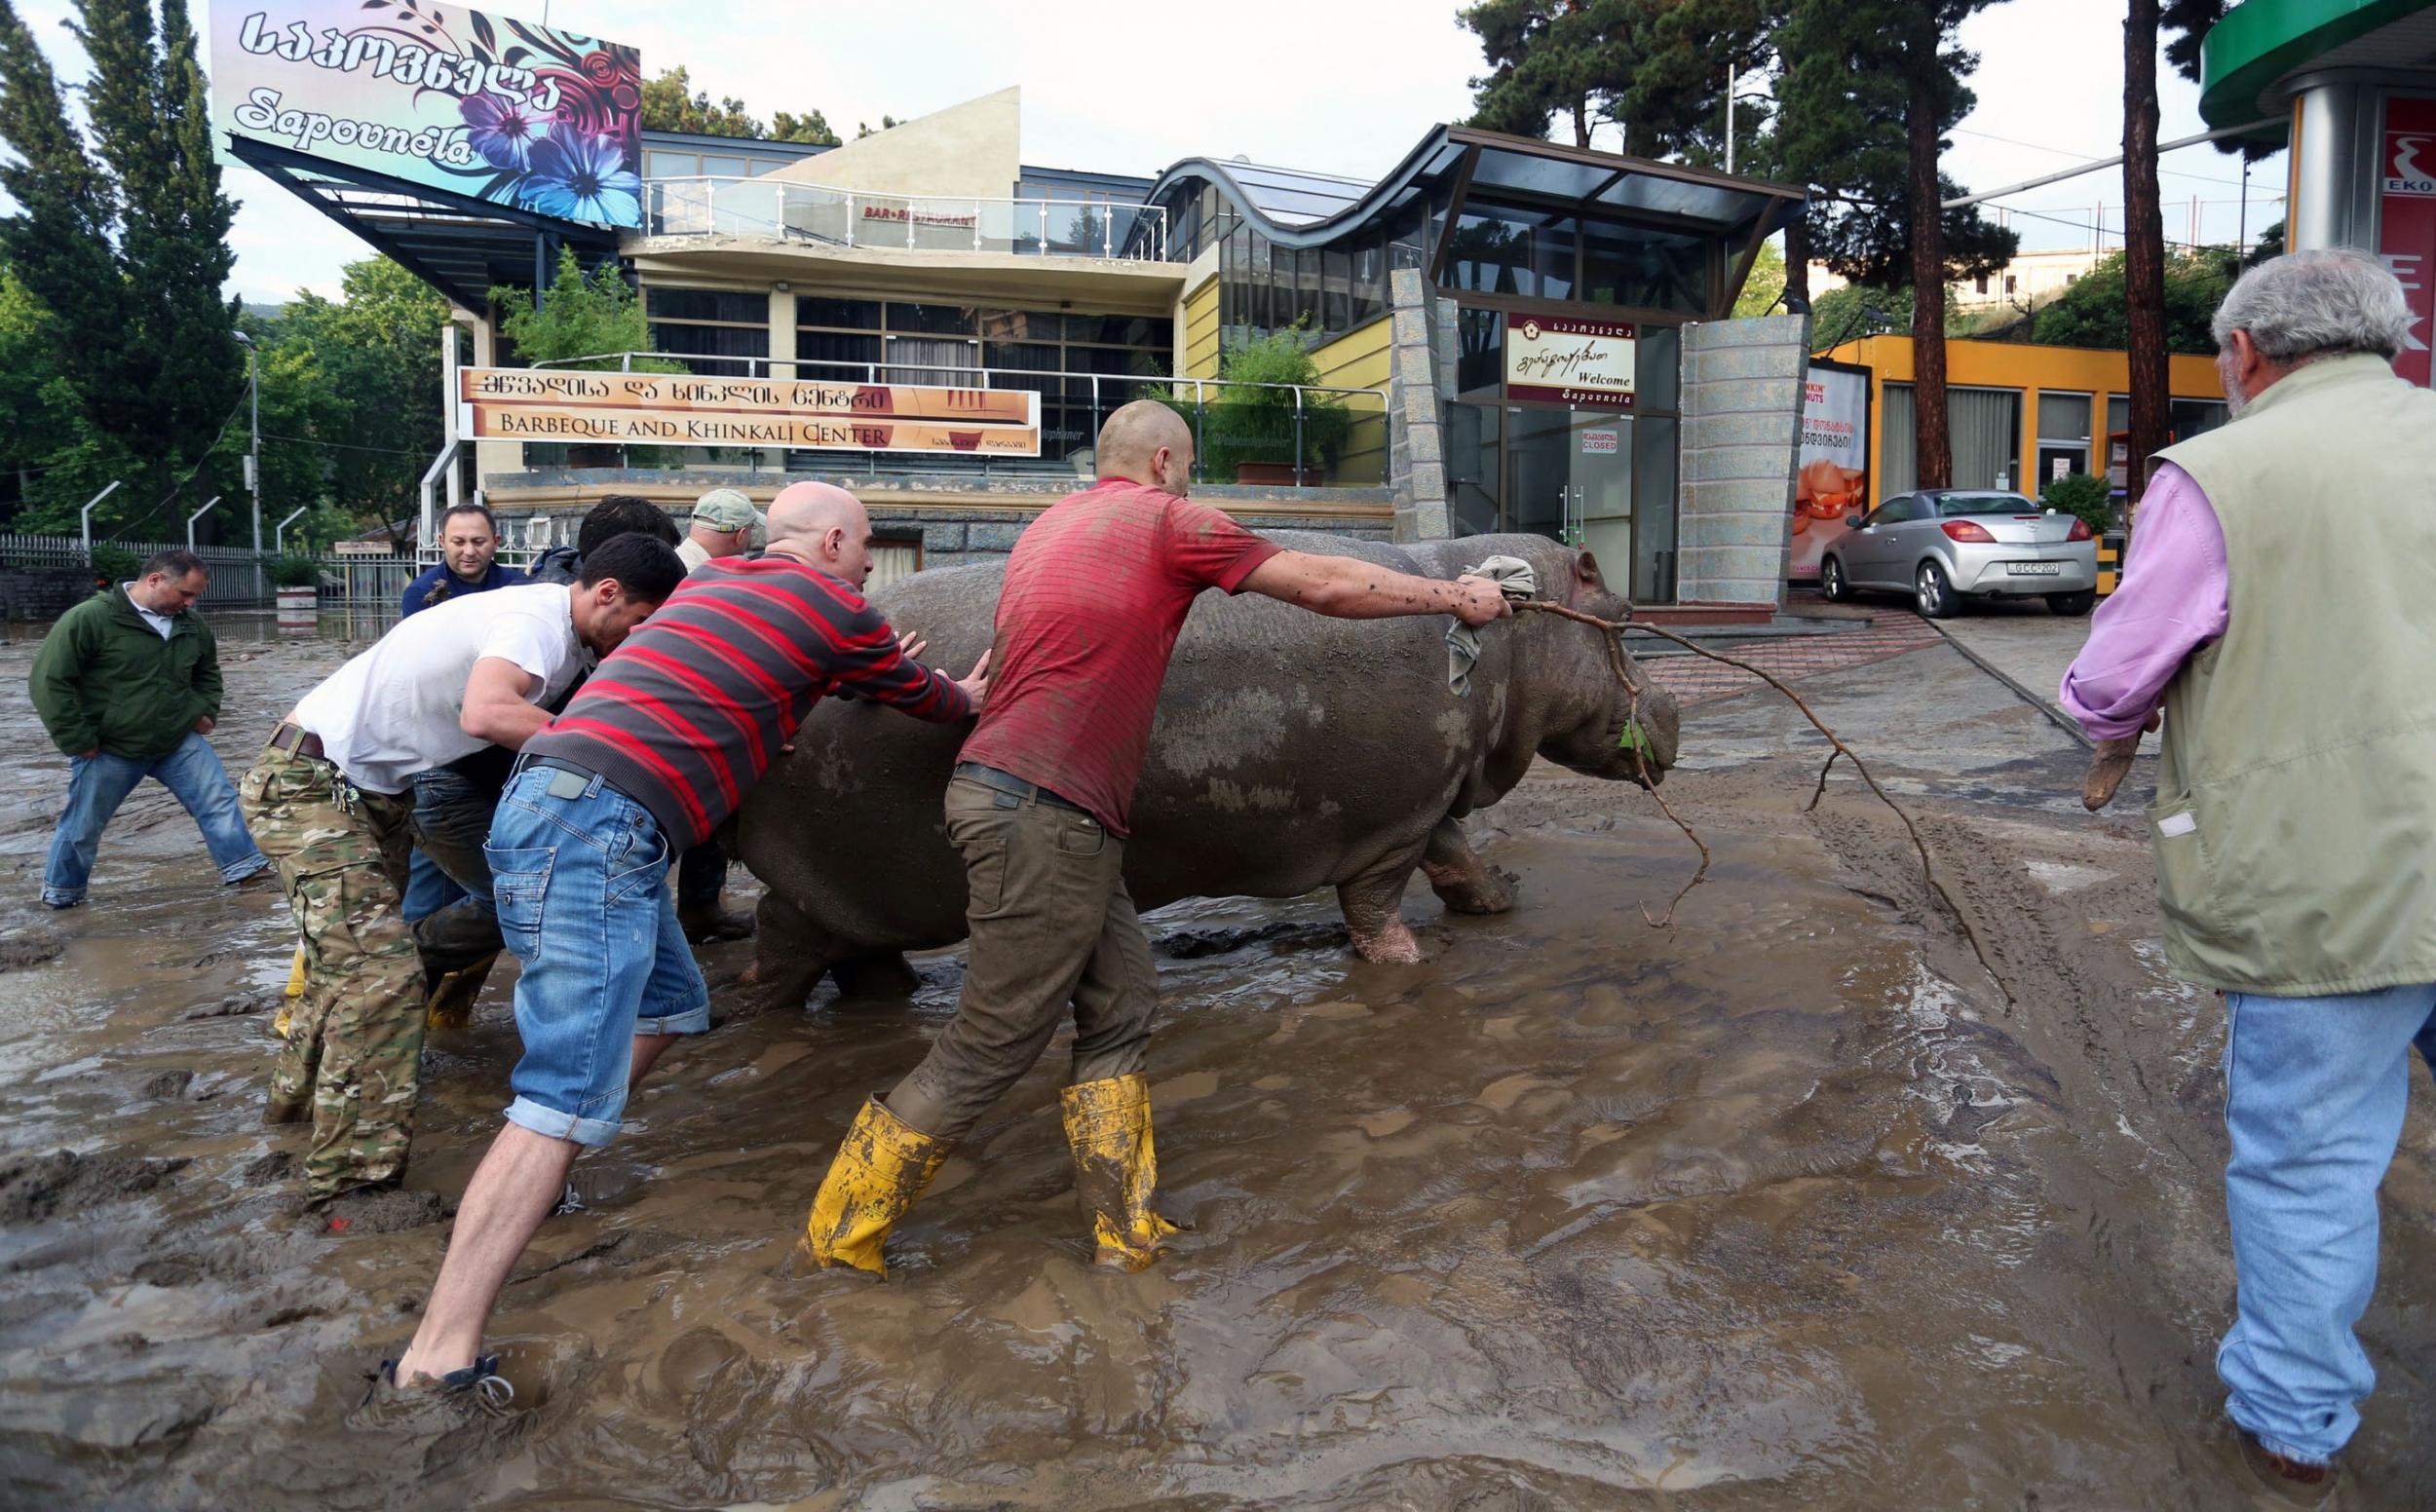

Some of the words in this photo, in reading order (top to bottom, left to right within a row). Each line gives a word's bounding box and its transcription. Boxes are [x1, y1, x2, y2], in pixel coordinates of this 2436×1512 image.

[239, 12, 561, 111] საპოვნელა
[2388, 179, 2433, 192] EKO
[483, 375, 610, 397] მწვადისა
[624, 381, 658, 398] და
[1579, 372, 1630, 387] Welcome
[1562, 389, 1630, 403] Sapovnela
[1804, 393, 1824, 403] NUTS
[501, 413, 619, 437] BARBEQUE
[627, 421, 677, 437] AND
[687, 420, 794, 441] KHINKALI
[803, 423, 888, 445] CENTER
[1582, 440, 1617, 450] CLOSED
